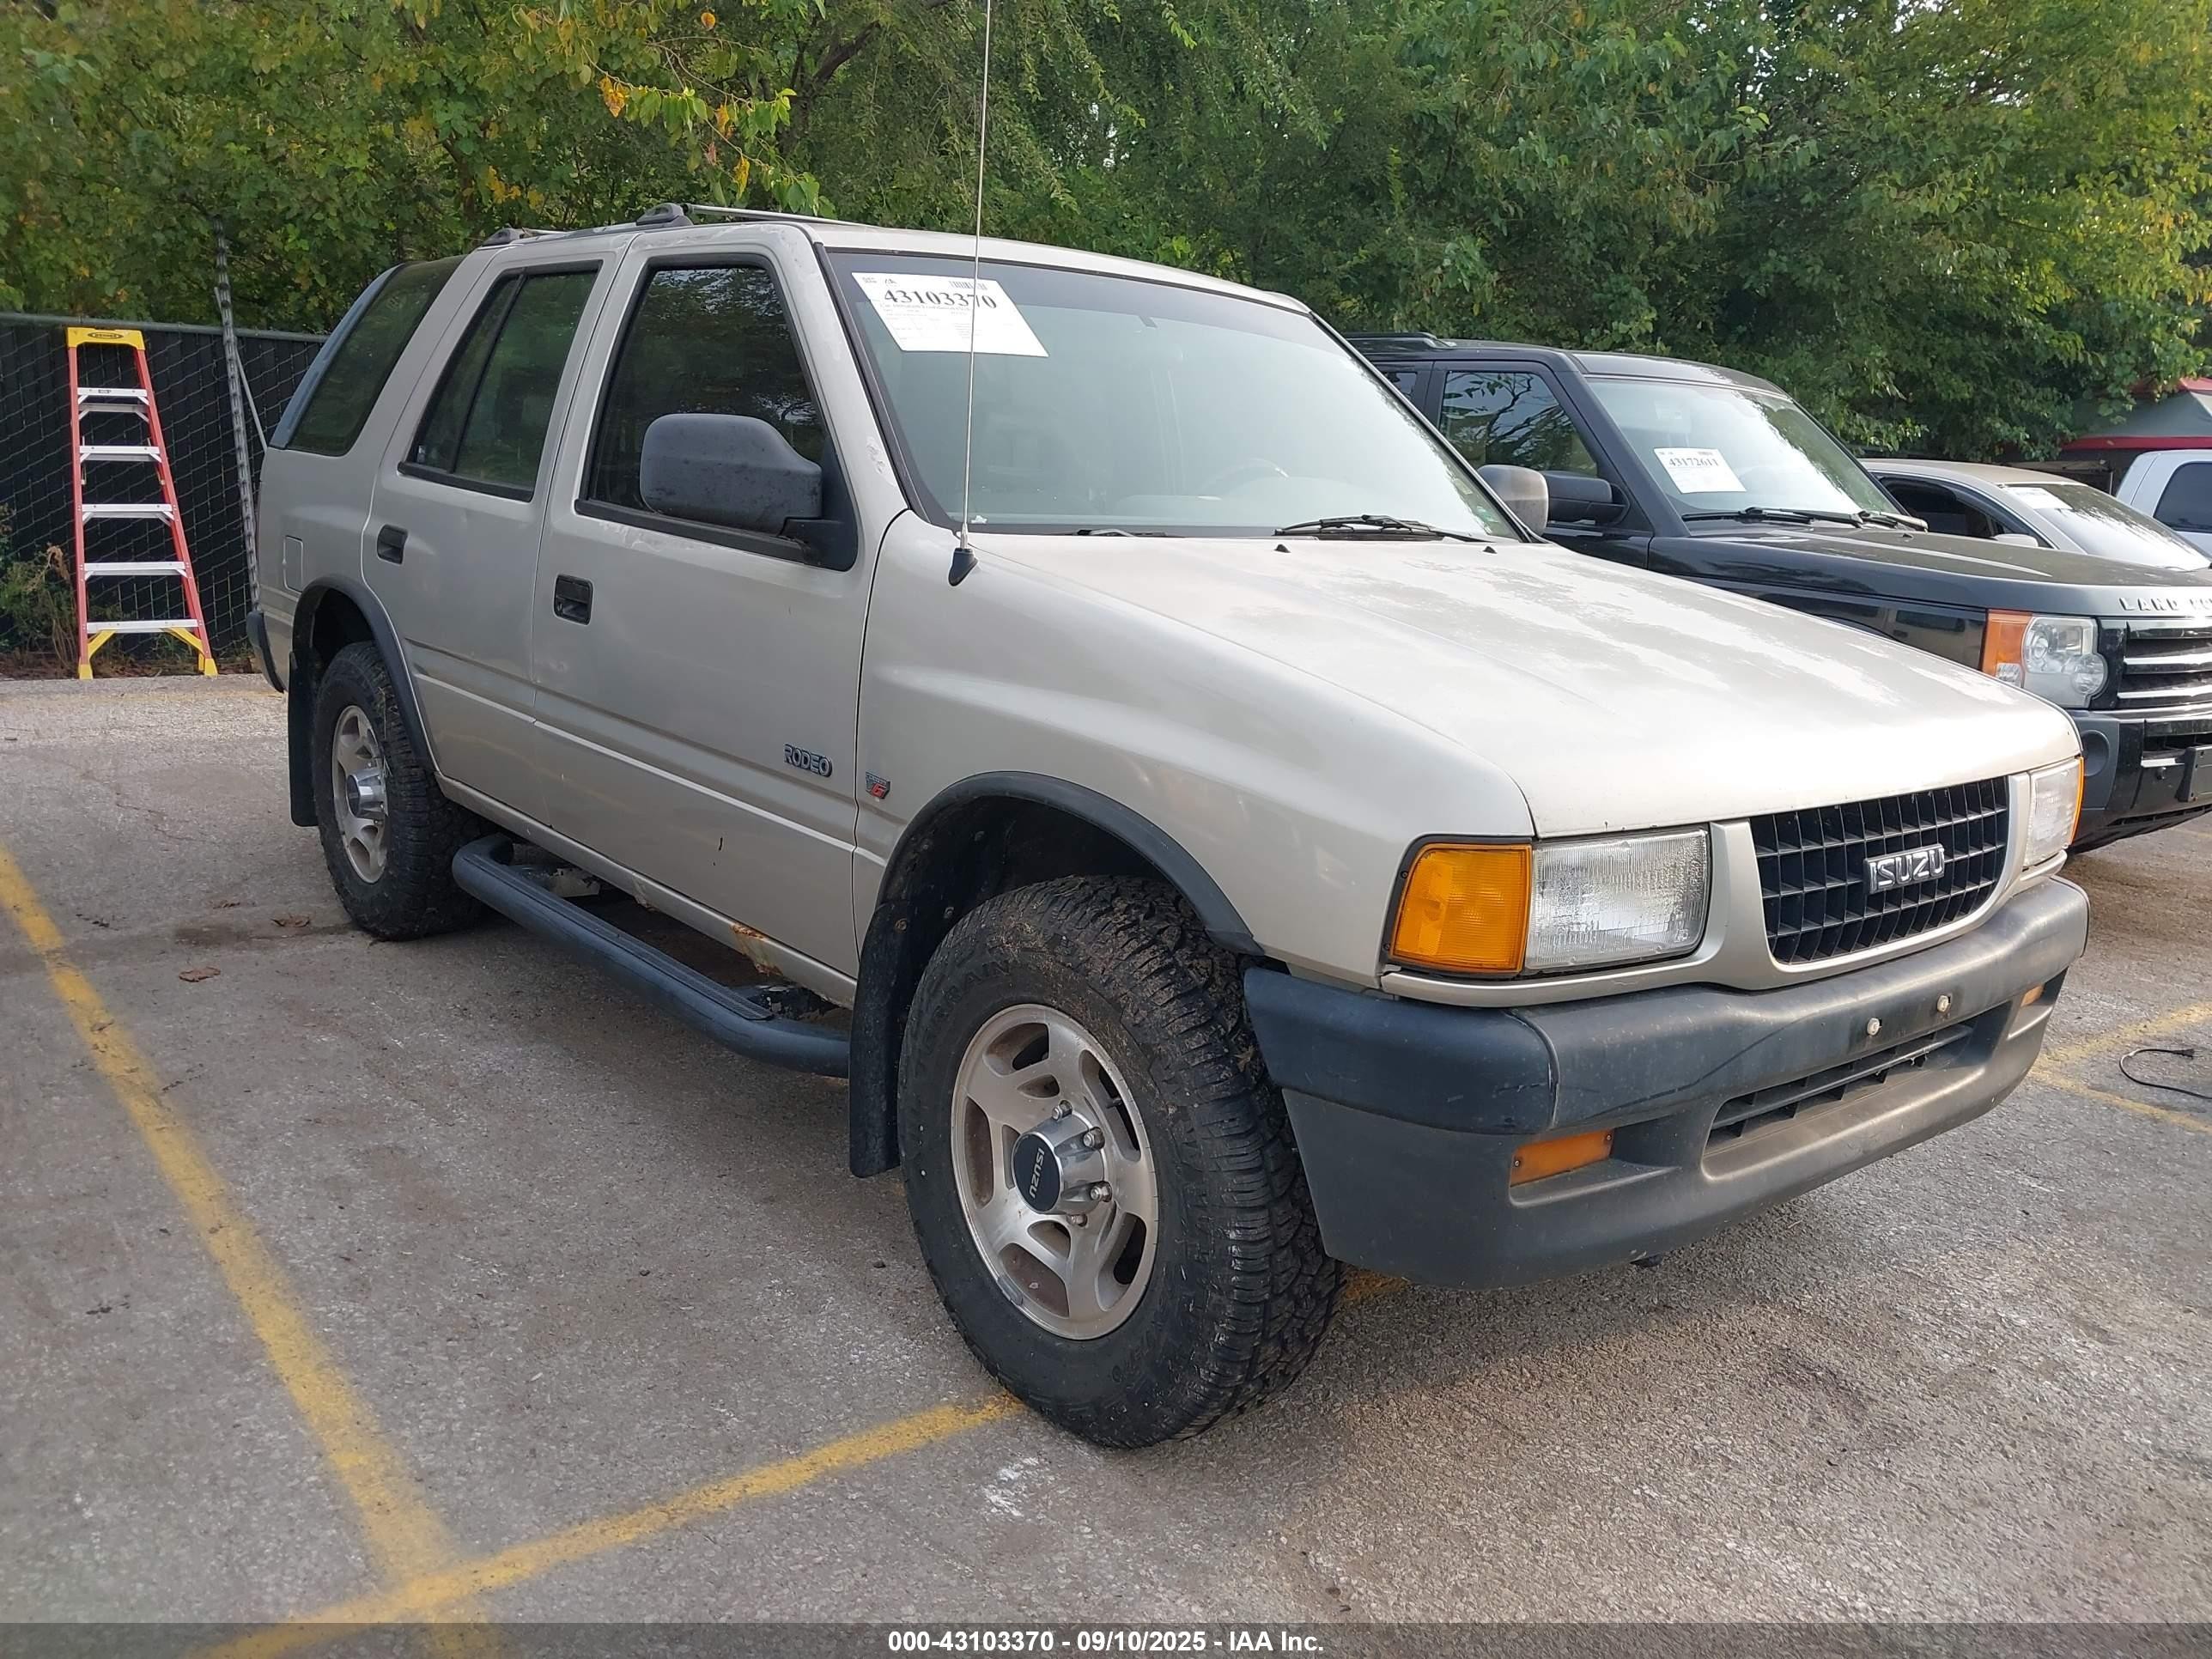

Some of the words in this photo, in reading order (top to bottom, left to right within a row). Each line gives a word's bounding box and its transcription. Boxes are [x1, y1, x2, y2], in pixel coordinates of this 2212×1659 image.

[884, 289, 997, 309] 43103370
[783, 743, 833, 777] RODEO
[1869, 848, 1944, 893] ISUZU
[1029, 1147, 1045, 1199] ISUZU
